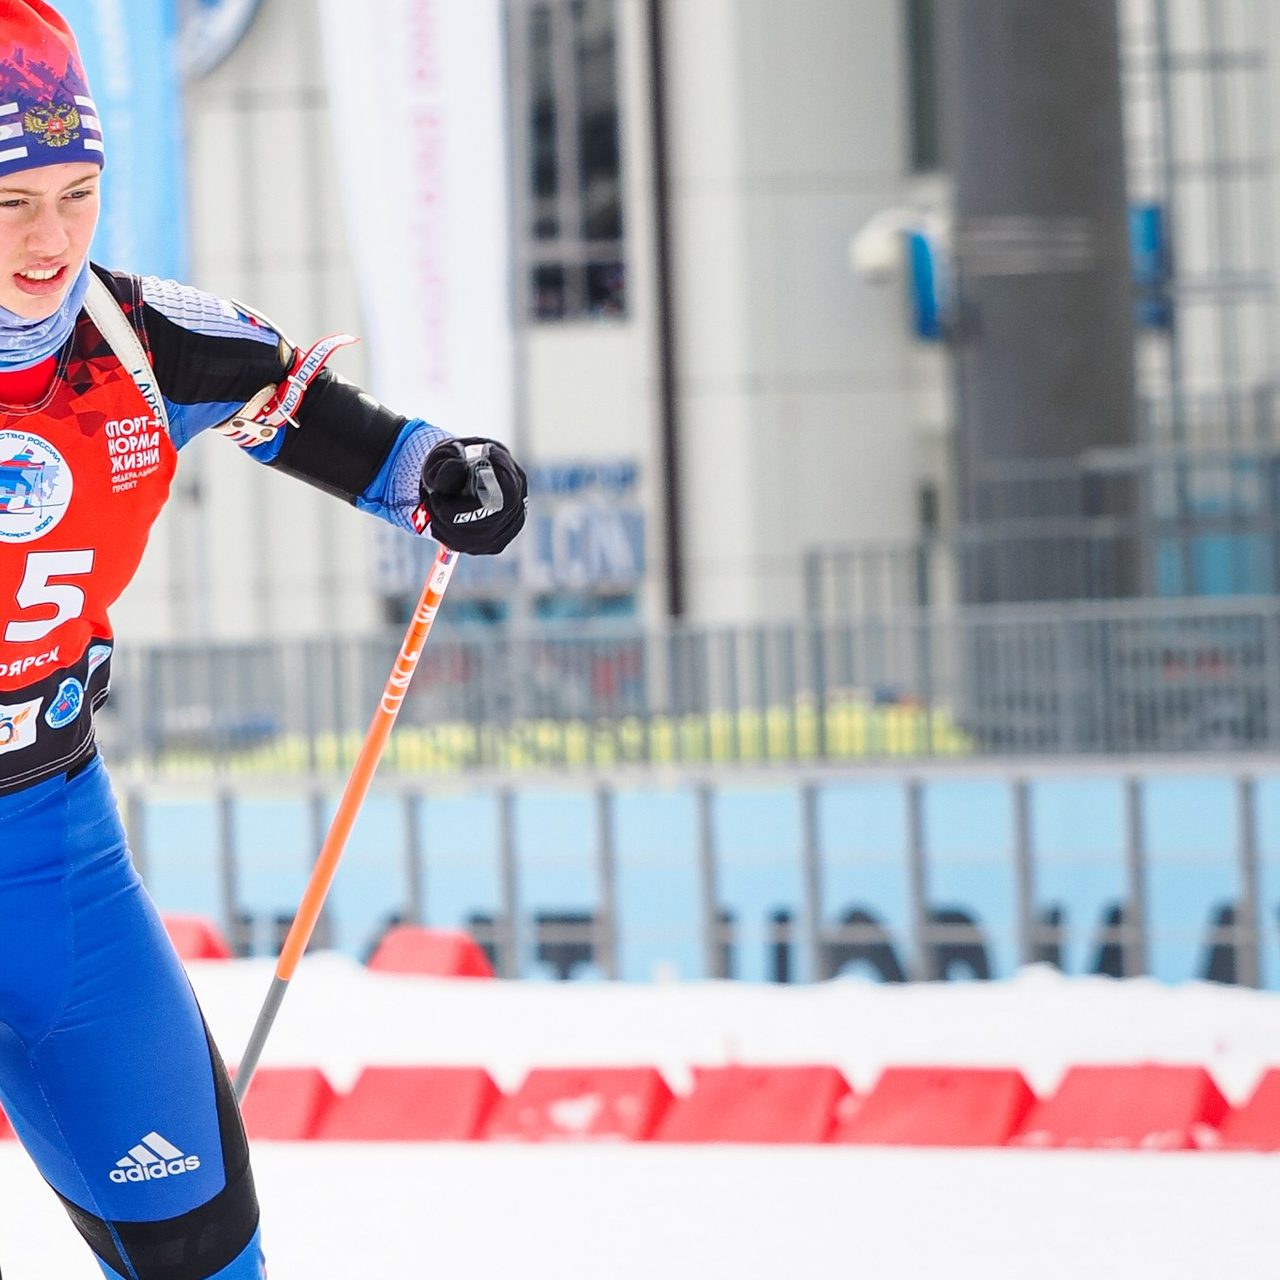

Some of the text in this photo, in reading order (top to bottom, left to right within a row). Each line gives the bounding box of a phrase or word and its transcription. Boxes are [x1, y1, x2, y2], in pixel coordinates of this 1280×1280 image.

[27, 436, 61, 463] РОССИИ
[107, 431, 160, 456] НОРМА
[110, 447, 160, 474] ЖИЗНИ
[112, 480, 138, 493] ПРОЕКТ
[34, 515, 54, 532] 2023
[109, 1155, 201, 1183] adidas
